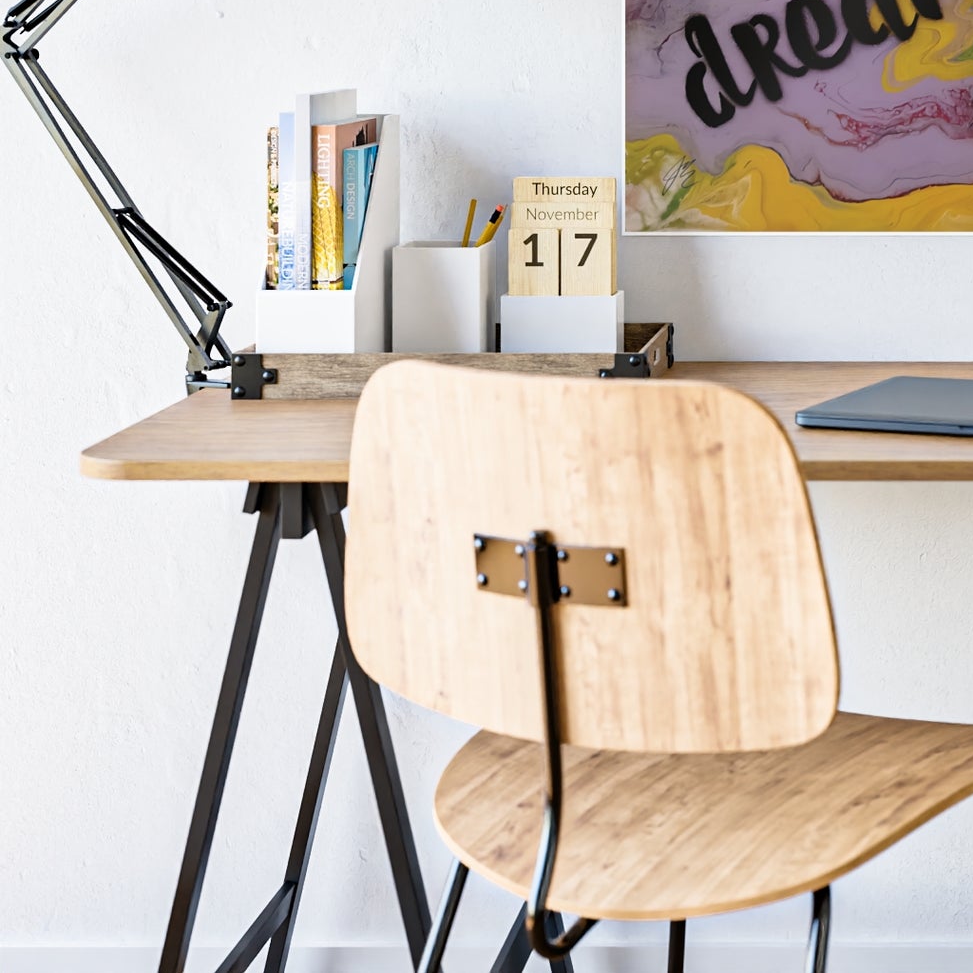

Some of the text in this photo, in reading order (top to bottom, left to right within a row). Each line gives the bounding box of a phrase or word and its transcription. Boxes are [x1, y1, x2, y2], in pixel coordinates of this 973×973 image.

[317, 134, 331, 209] LIGHTING
[346, 153, 356, 220] ARCH DESIGN
[532, 182, 598, 198] Thursday
[526, 208, 599, 220] November
[297, 233, 308, 289] MODERN
